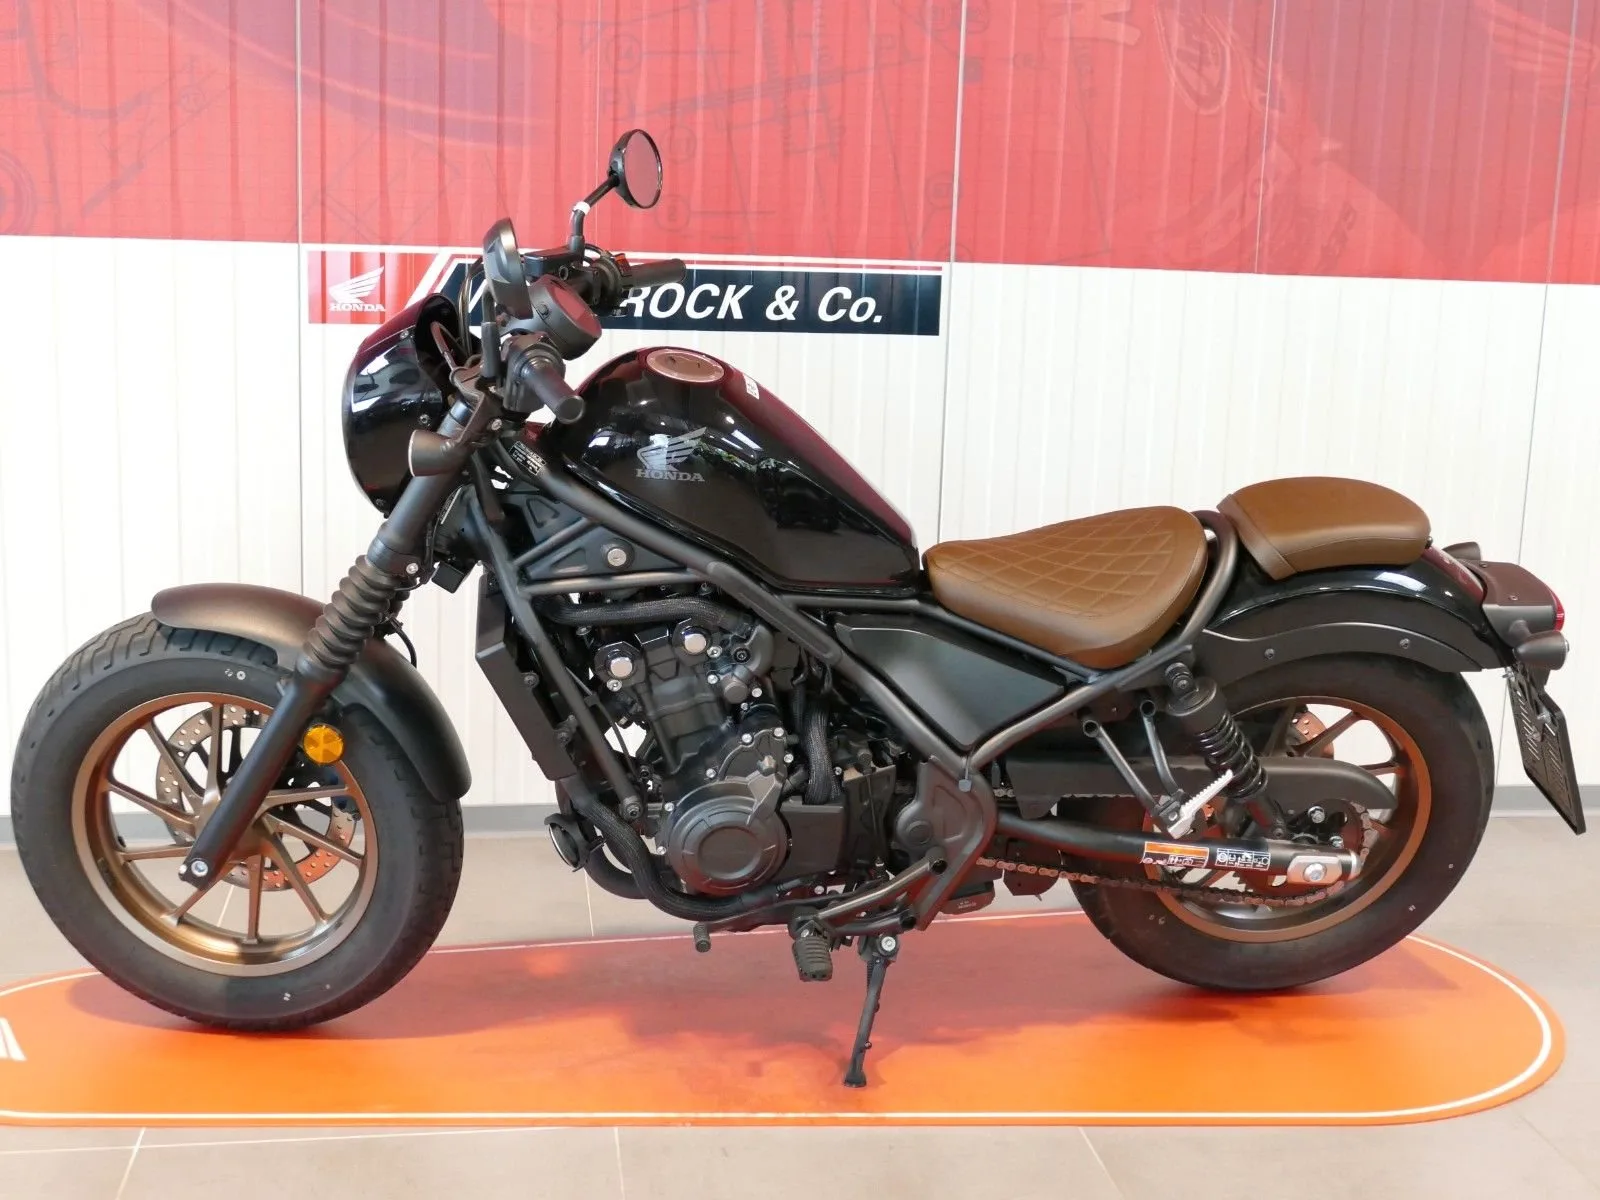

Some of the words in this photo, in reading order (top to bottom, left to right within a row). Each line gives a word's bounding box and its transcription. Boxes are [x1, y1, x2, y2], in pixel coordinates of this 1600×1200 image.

[329, 303, 386, 312] HONDA
[620, 282, 752, 319] ROCK
[765, 285, 799, 321] &
[817, 287, 882, 323] Co.
[635, 468, 705, 482] HONDA
